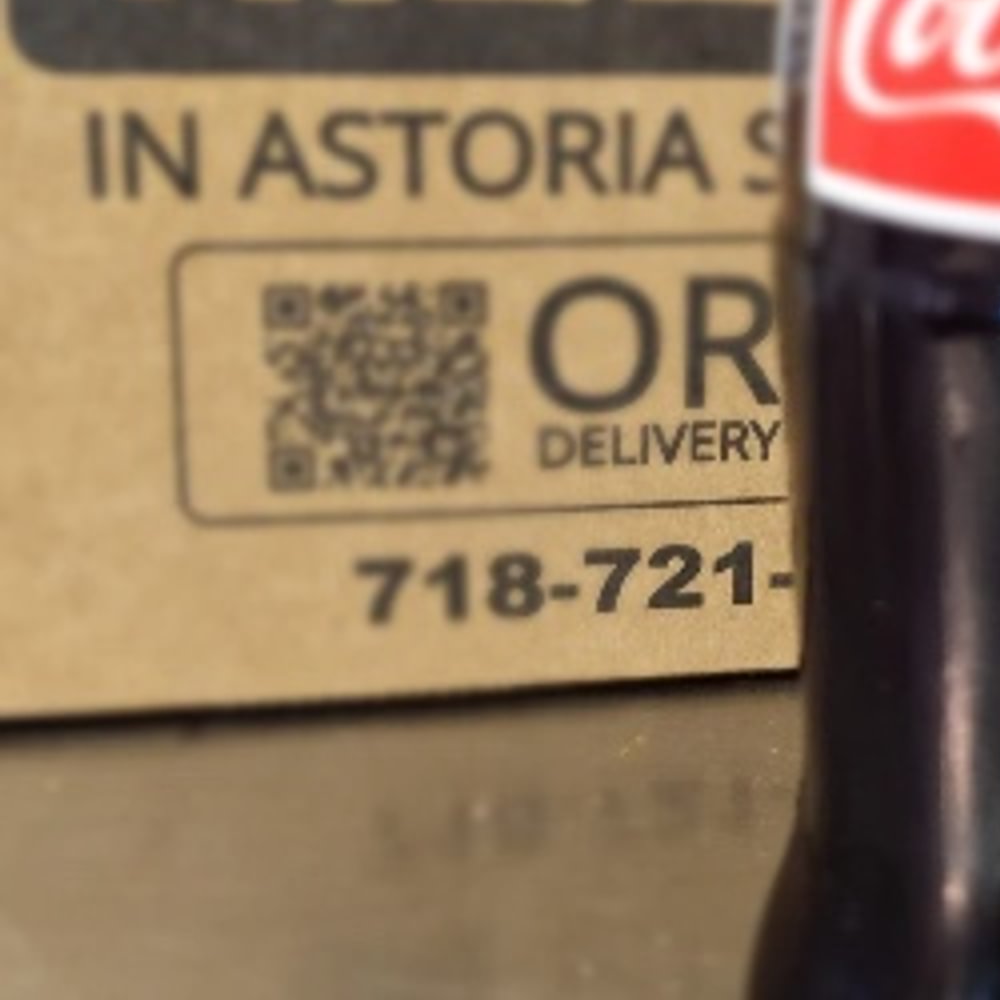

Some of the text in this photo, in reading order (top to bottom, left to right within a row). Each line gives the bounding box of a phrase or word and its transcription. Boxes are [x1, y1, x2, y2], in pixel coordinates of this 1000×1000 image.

[87, 109, 199, 201] IN
[239, 108, 713, 198] ASTORIA
[537, 420, 781, 470] DELIVERY
